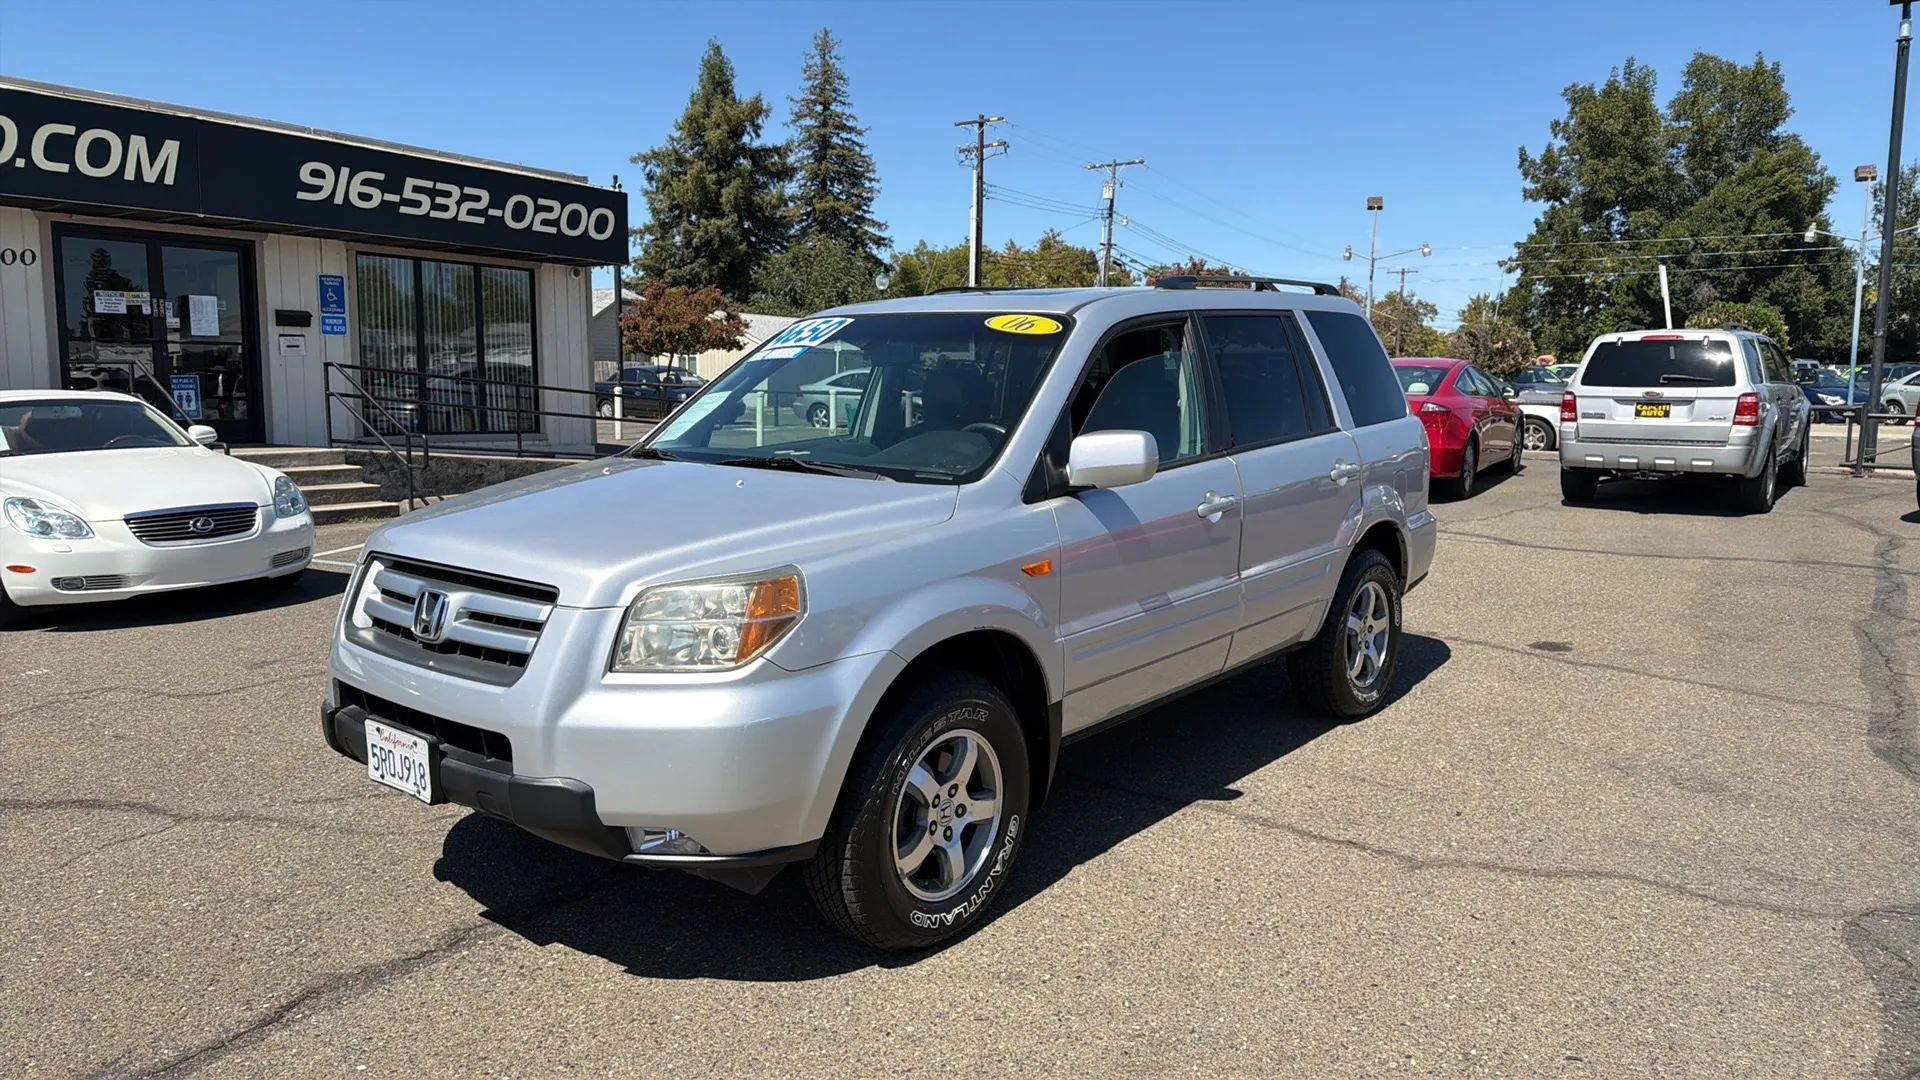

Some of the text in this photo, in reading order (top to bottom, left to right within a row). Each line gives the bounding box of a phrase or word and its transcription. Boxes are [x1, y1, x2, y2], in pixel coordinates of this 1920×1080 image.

[296, 161, 615, 241] 916-532-0200
[380, 728, 414, 751] California
[910, 814, 1020, 928] GRANTLAND
